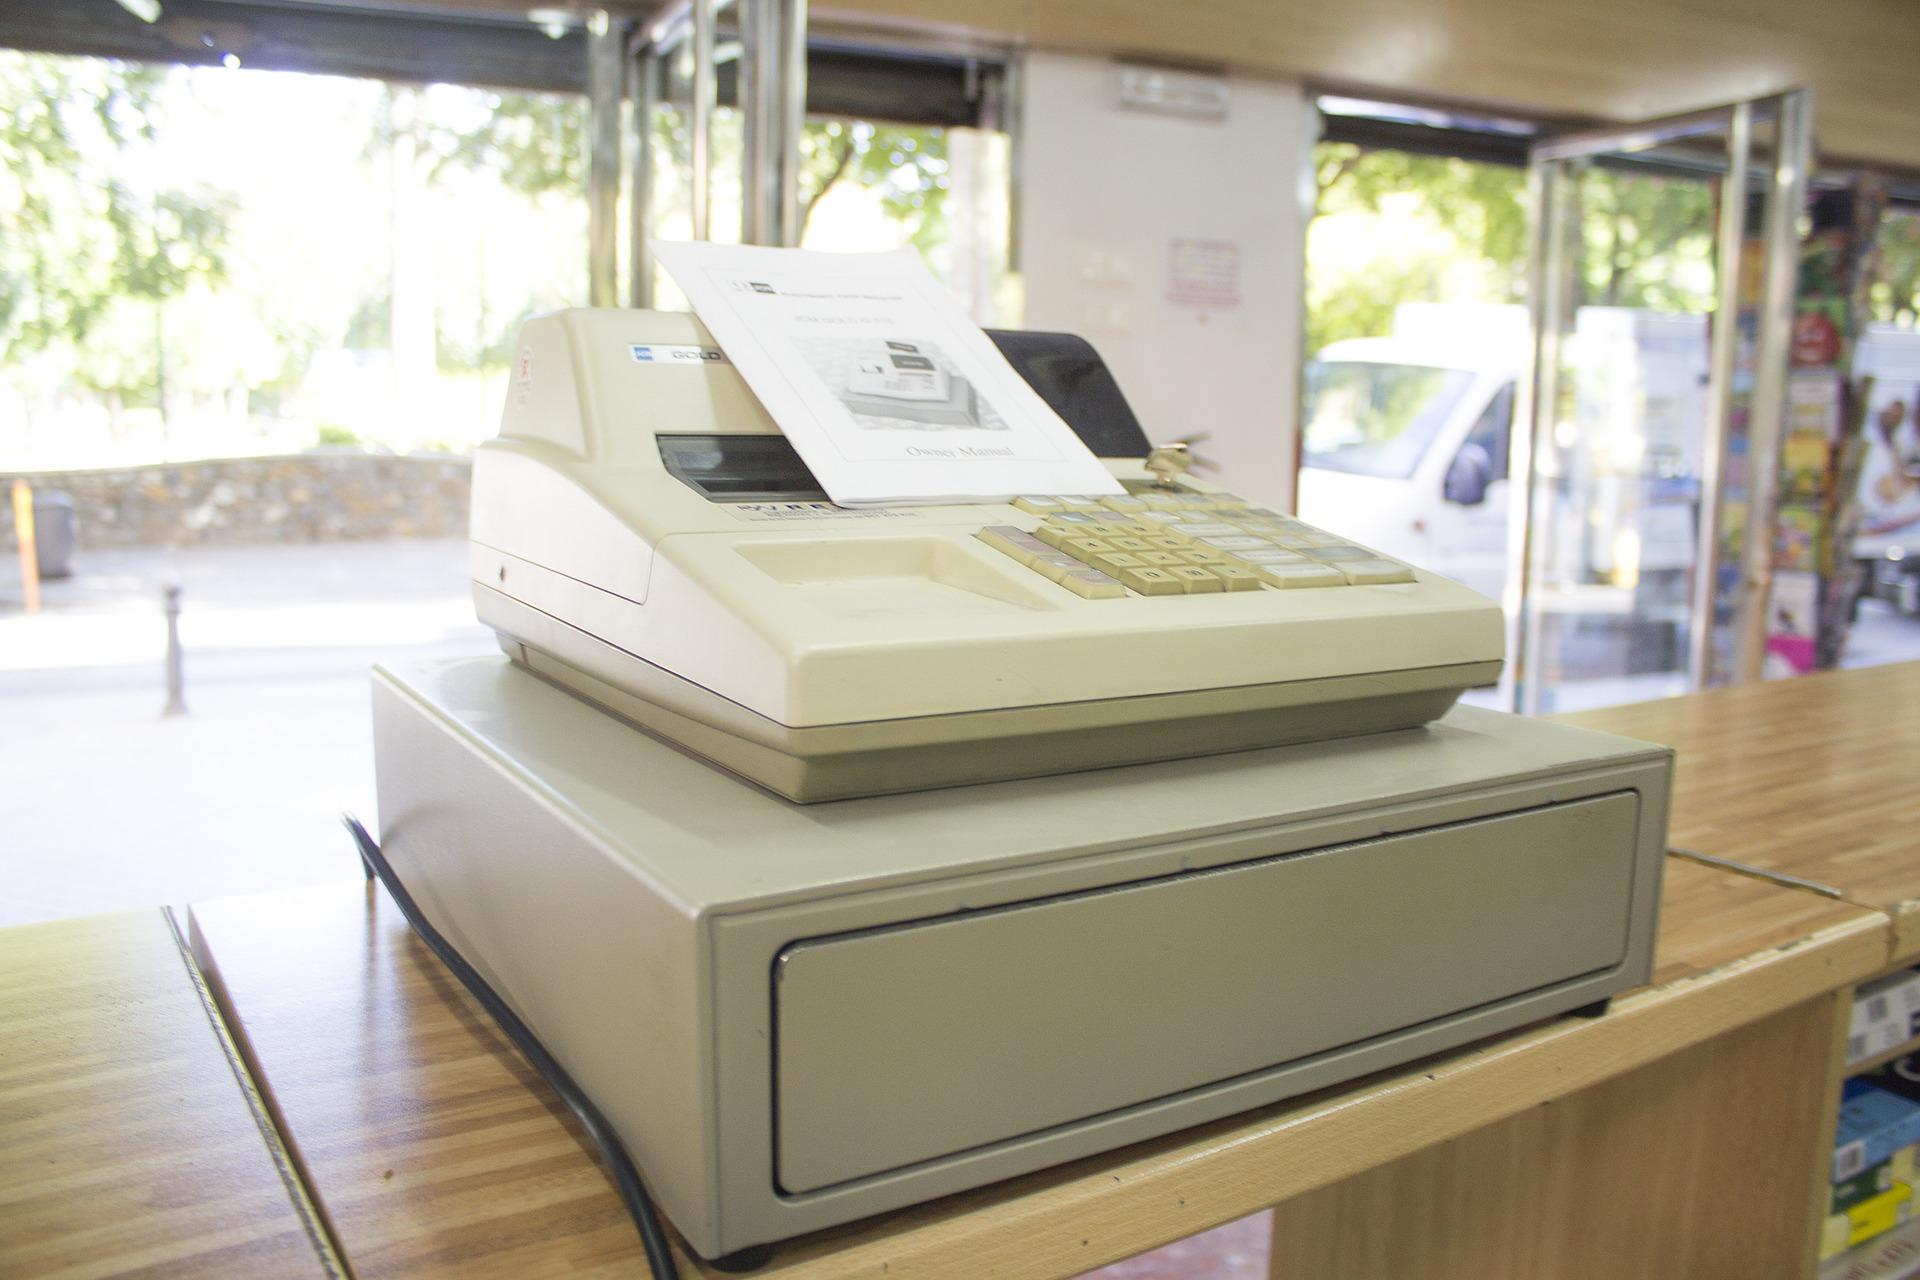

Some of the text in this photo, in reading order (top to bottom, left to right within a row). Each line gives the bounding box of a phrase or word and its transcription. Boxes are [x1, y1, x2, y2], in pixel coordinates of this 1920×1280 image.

[672, 350, 722, 361] GOLD
[905, 446, 1015, 458] Owner Manual
